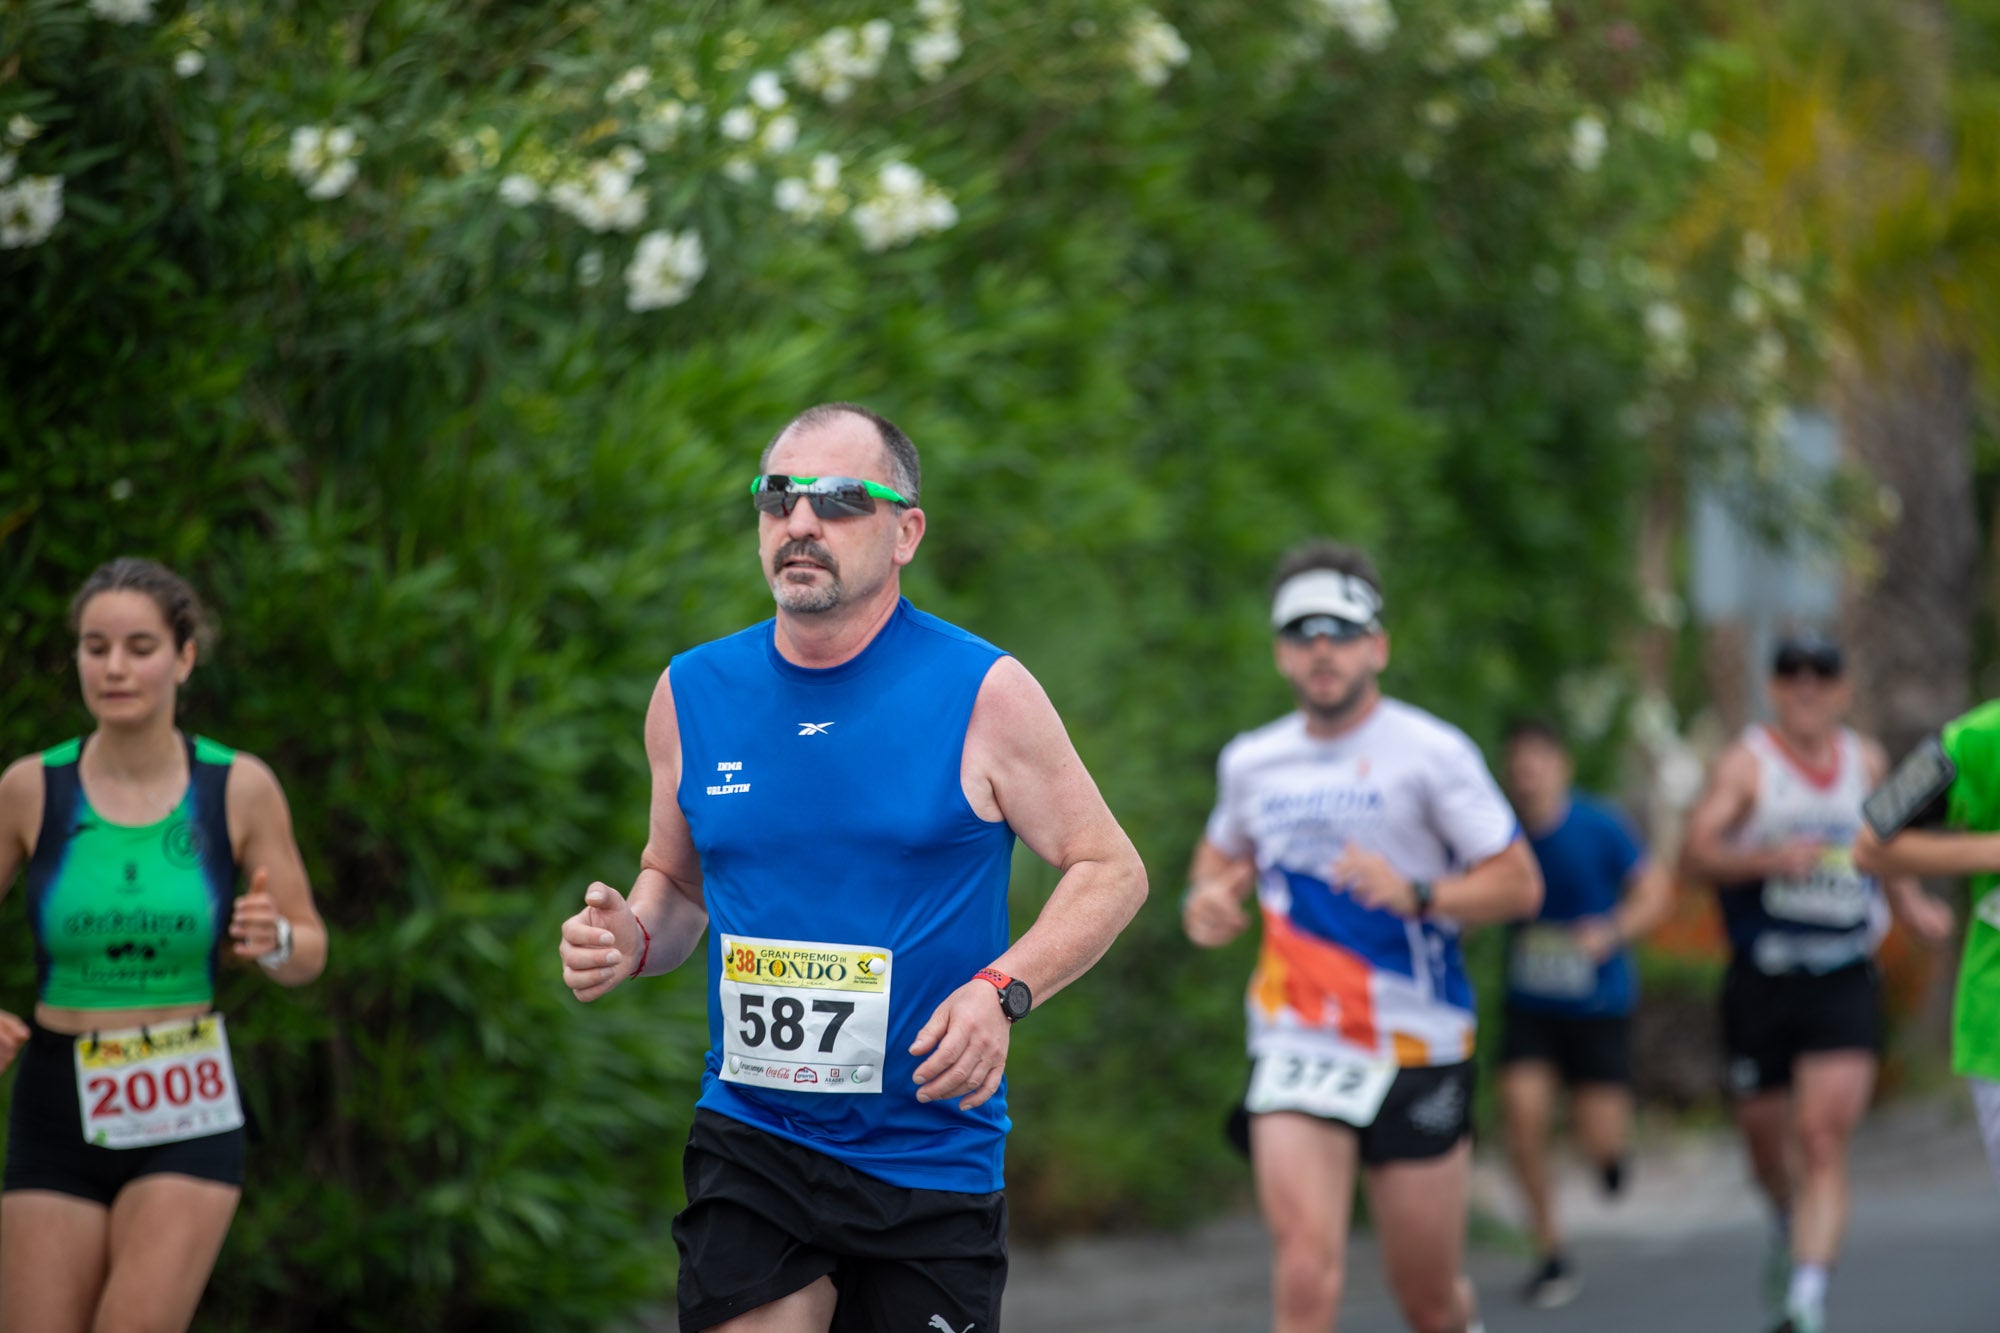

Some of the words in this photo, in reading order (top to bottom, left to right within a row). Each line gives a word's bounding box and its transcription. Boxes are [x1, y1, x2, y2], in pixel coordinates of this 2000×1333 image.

[706, 783, 750, 795] VALENTIN
[725, 773, 733, 782] Y
[735, 948, 755, 973] 38
[760, 949, 790, 960] GRAN
[793, 951, 838, 963] PREMIO
[755, 958, 847, 981] FONDO
[739, 993, 855, 1053] 587
[1279, 1056, 1367, 1094] 372
[87, 1057, 226, 1120] 2008
